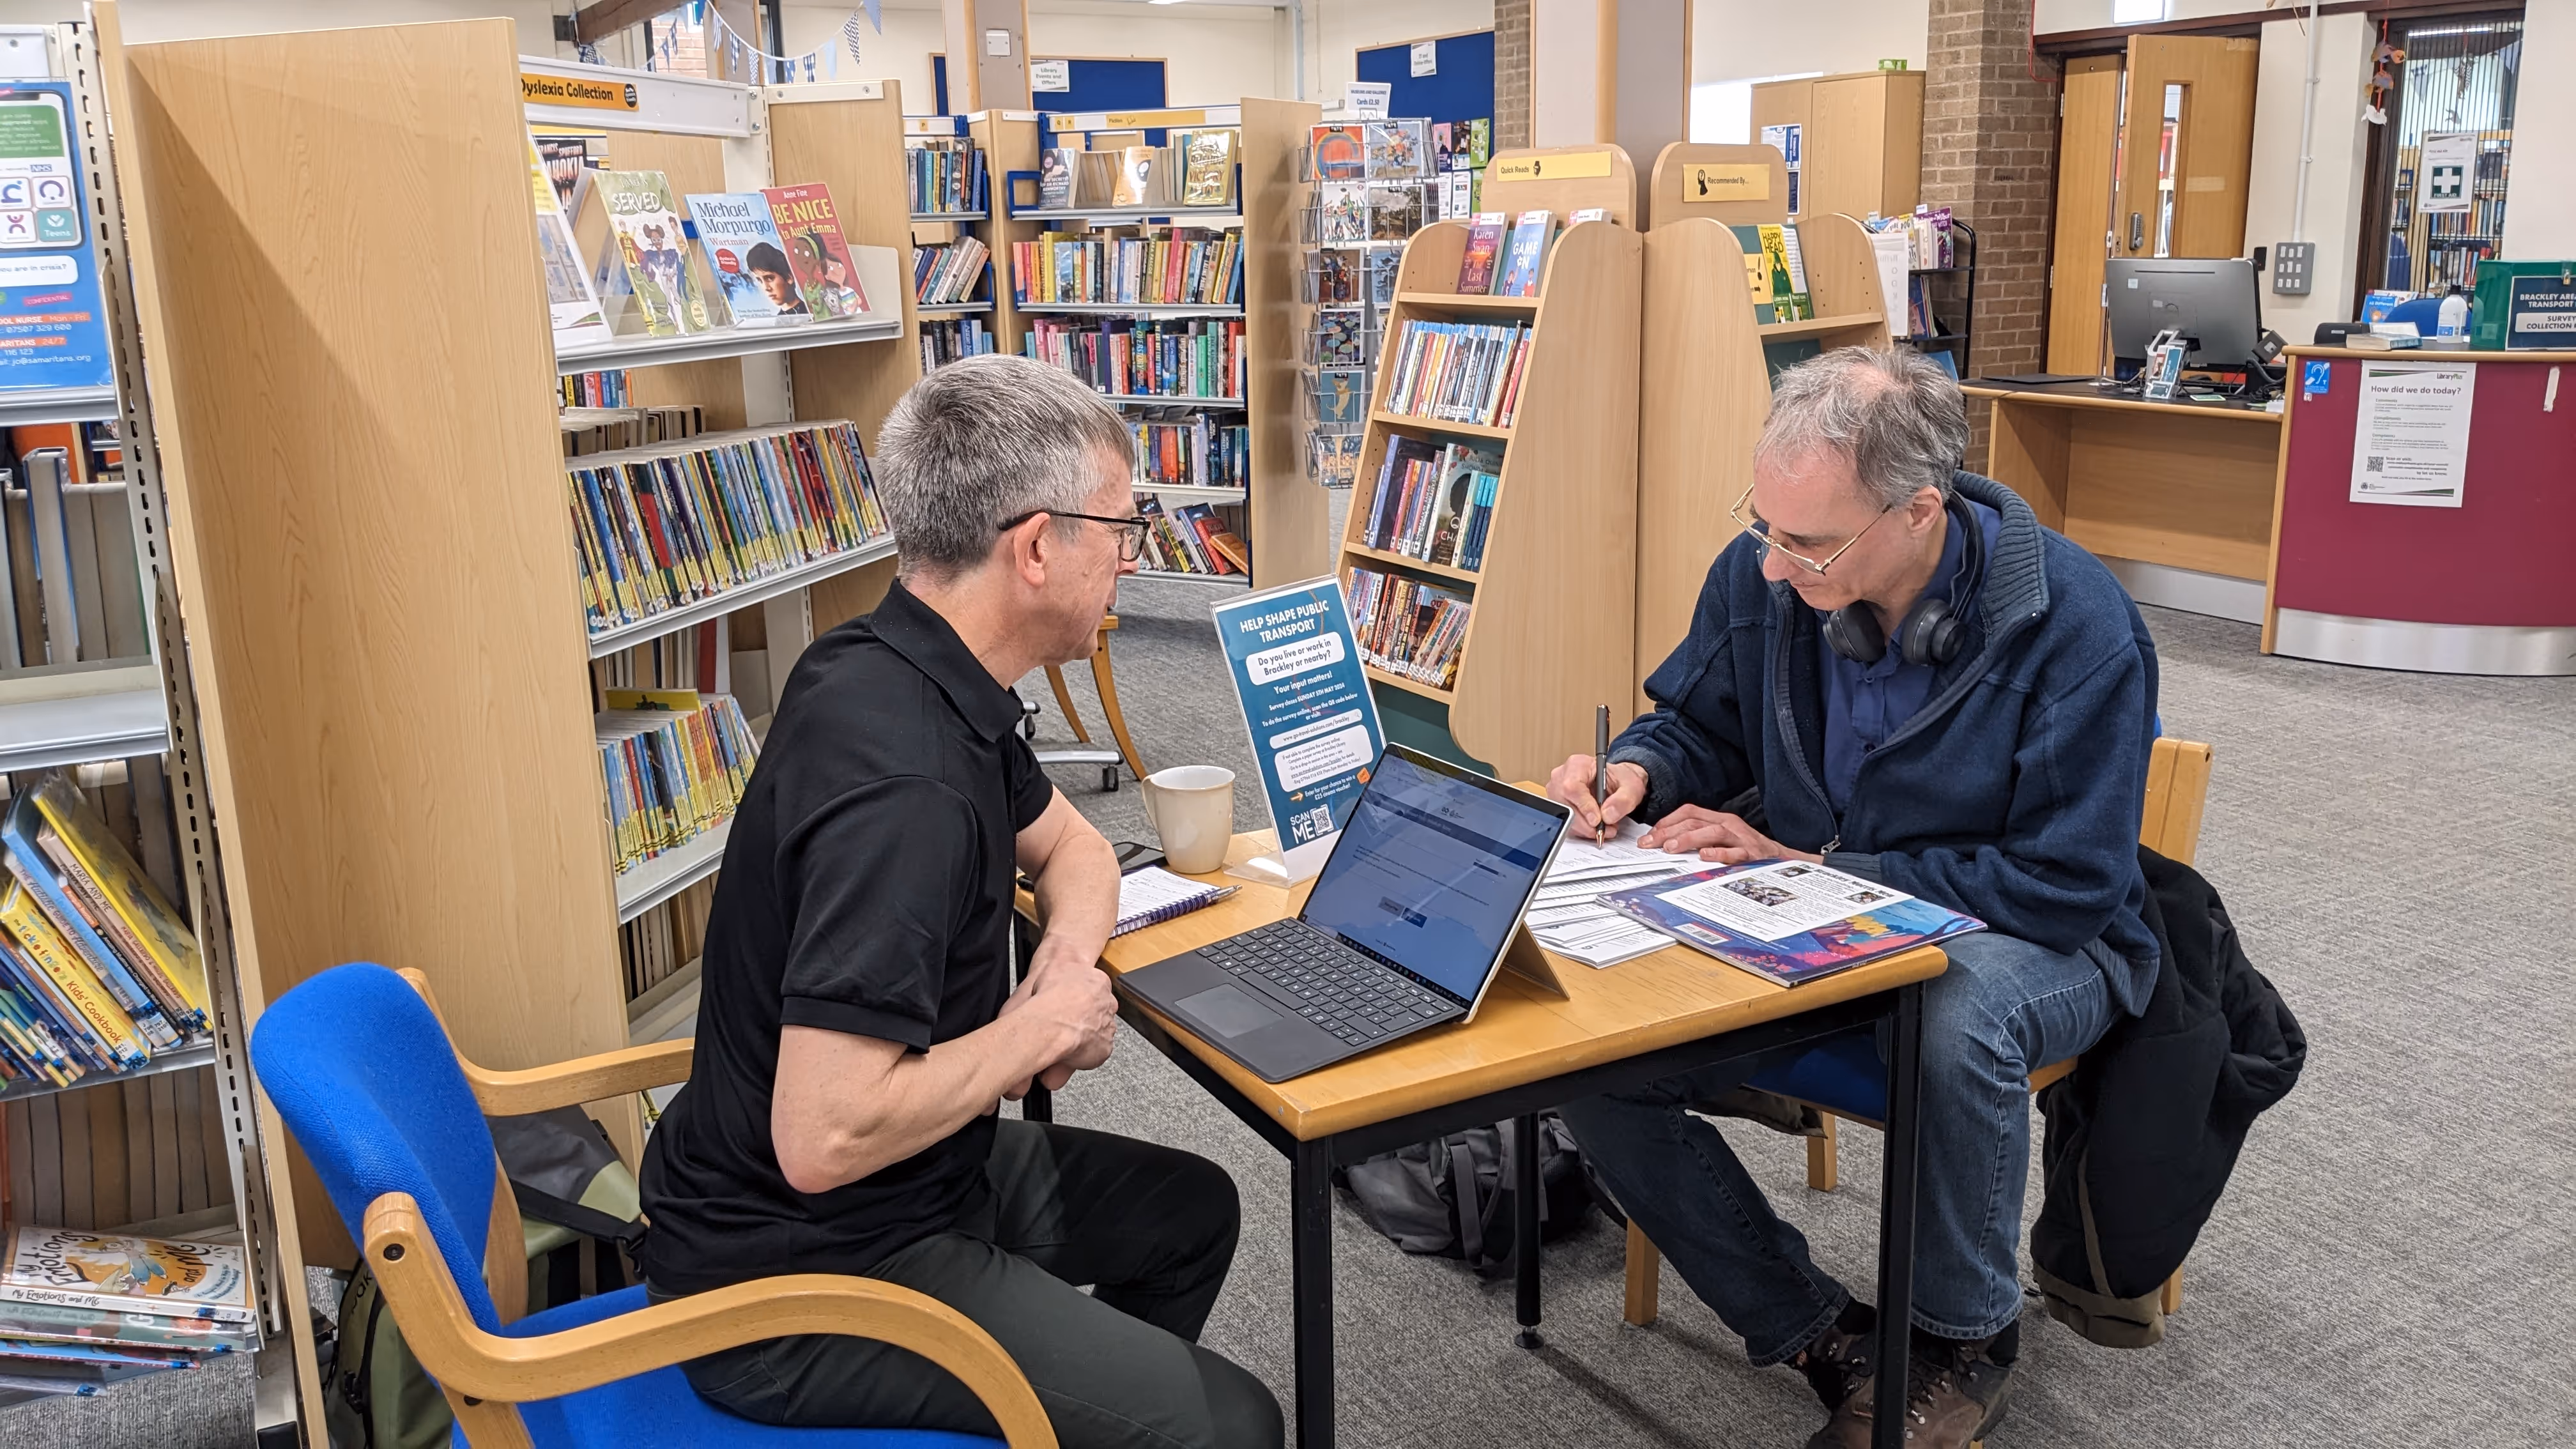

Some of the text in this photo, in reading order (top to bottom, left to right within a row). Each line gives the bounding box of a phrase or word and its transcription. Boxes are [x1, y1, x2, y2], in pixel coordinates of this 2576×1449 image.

[567, 82, 613, 101] Collection
[612, 192, 660, 213] SERVED
[695, 202, 750, 218] Michael
[772, 199, 834, 224] BE NICE
[702, 218, 770, 236] Morpurgo
[781, 223, 836, 240] to Aunt Emma
[1474, 227, 1493, 240] Karen
[709, 237, 749, 246] Wartman
[1762, 233, 1781, 243] HAPPY
[1472, 241, 1489, 253] Swan
[1513, 242, 1538, 254] GAME
[1765, 243, 1784, 253] HEAD
[1468, 269, 1482, 281] Last
[1460, 282, 1487, 293] Summer
[12, 355, 91, 366] jo@samaritans.org
[2433, 387, 2461, 395] today?
[1450, 518, 1461, 529] Q
[1240, 600, 1330, 633] HELP SHAPE PUBLIC
[1259, 618, 1315, 643] TRANSPORT
[1258, 657, 1268, 666] Do
[1269, 655, 1283, 666] you
[1284, 650, 1296, 659] live
[1306, 641, 1324, 653] work
[1264, 661, 1294, 676] Brackley
[1304, 650, 1331, 665] nearby?
[1273, 670, 1333, 694] Your input matters!
[1269, 702, 1284, 711] Survey
[1298, 692, 1315, 702] SUNDAY
[1335, 682, 1345, 691] 2024
[1283, 712, 1297, 721] survey
[1283, 716, 1349, 742] www.go-travel-solutions.com/brackley
[1323, 789, 1335, 797] cinema
[1336, 783, 1351, 793] voucher!
[1291, 810, 1310, 825] SCAN
[1292, 820, 1315, 844] ME
[89, 886, 102, 901] AND
[100, 901, 111, 912] ME
[28, 880, 56, 912] Autistic
[53, 910, 69, 928] GUIDE
[66, 927, 75, 936] TO
[72, 935, 104, 972] Adventure
[103, 936, 118, 952] Amazing
[116, 952, 129, 967] Muslims
[133, 972, 147, 990] Changed
[66, 980, 89, 1005] Kids'
[84, 1000, 122, 1045] Cookbook
[20, 1231, 100, 1285] Emotions
[178, 1266, 203, 1283] and
[12, 1289, 24, 1299] My
[26, 1290, 66, 1303] Emotions
